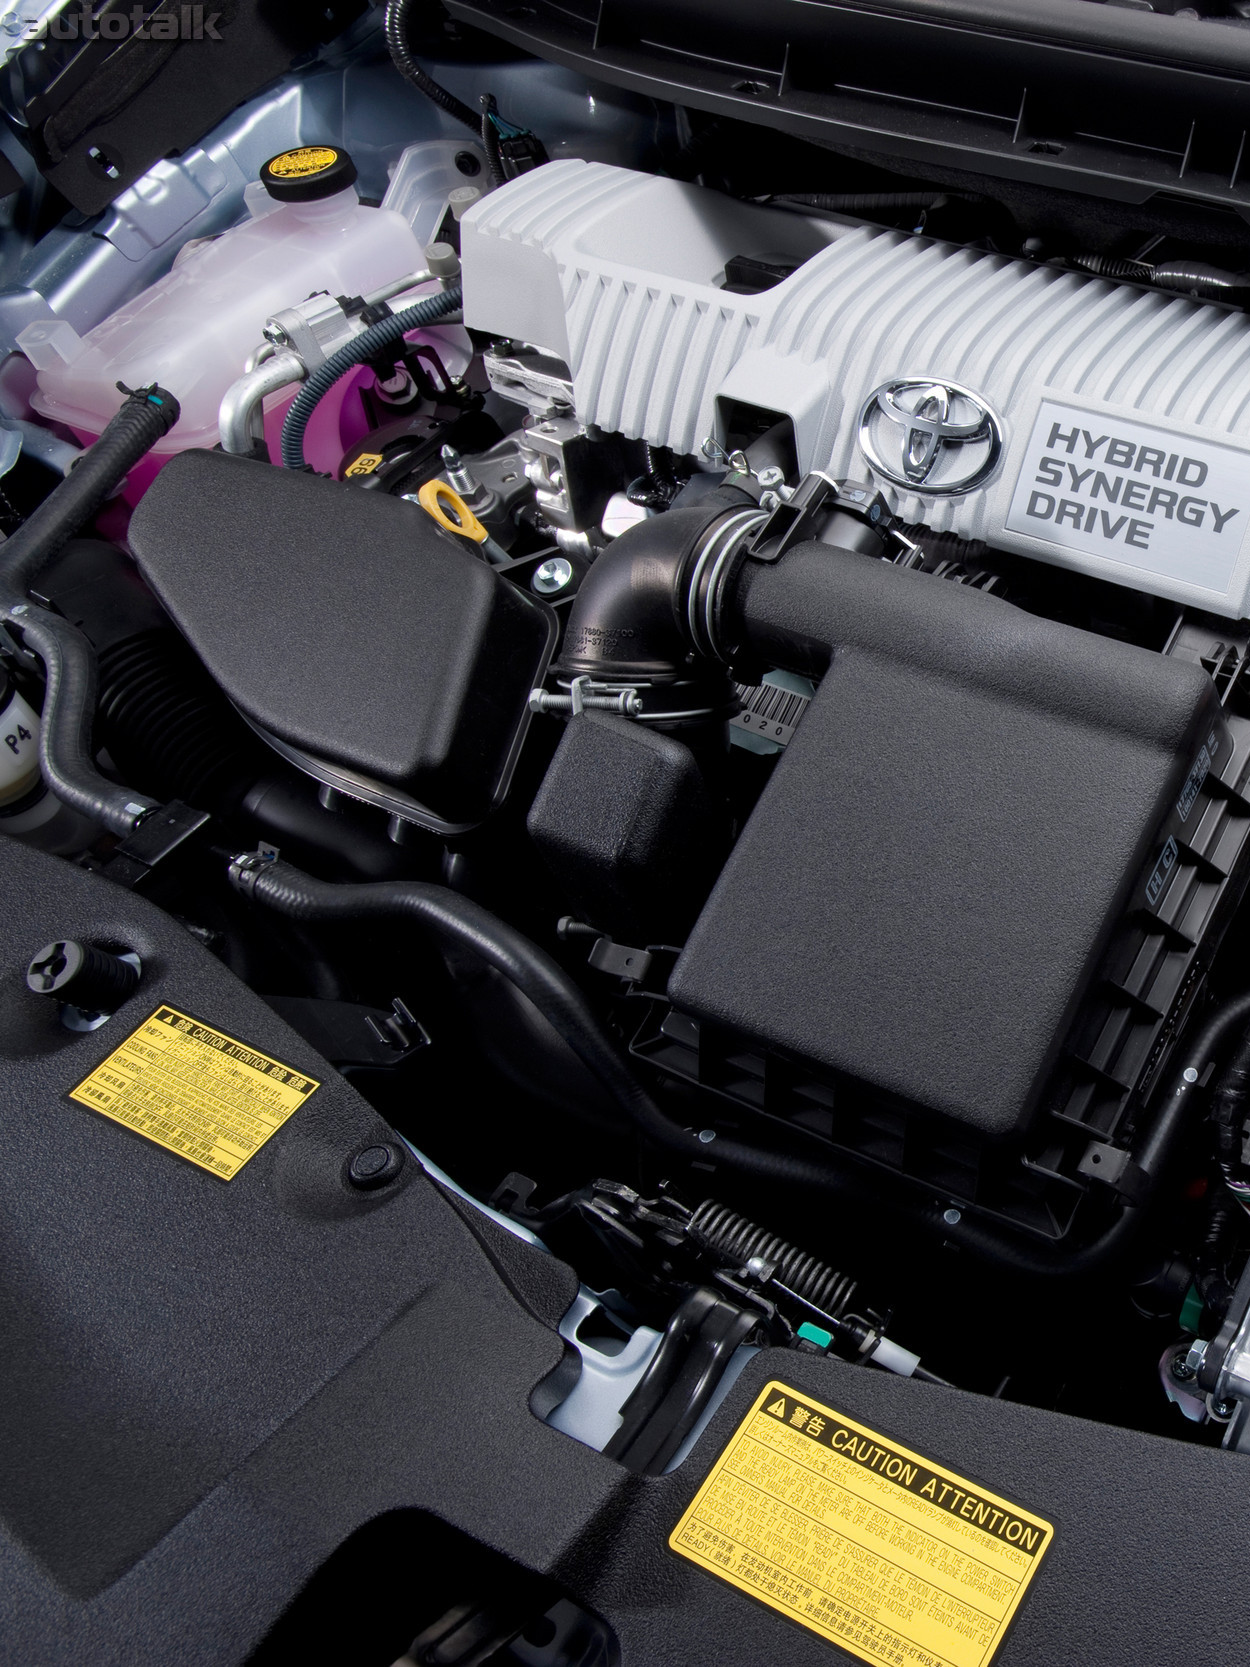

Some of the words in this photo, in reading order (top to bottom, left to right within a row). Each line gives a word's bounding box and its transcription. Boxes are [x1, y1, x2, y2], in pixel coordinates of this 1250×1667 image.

[1046, 422, 1208, 487] HYBRID
[1026, 490, 1154, 550] DRIVE
[1035, 456, 1240, 533] SYNERGY
[4, 724, 32, 755] P4
[190, 1027, 227, 1049] CAUTION
[224, 1044, 270, 1071] ATTENTION
[726, 1457, 741, 1471] SEE
[763, 1478, 790, 1498] MANUAL
[787, 1491, 803, 1506] FOR
[732, 1448, 748, 1462] AND
[746, 1455, 760, 1469] THE
[758, 1462, 780, 1480] READY
[777, 1472, 797, 1489] LAMP
[794, 1482, 807, 1495] ON
[804, 1487, 820, 1502] THE
[817, 1494, 840, 1513] METER
[838, 1505, 853, 1520] ARE
[851, 1513, 866, 1527] OFF
[864, 1520, 889, 1540] BEFORE
[887, 1532, 917, 1555] WORKING
[914, 1547, 925, 1560] IN
[923, 1552, 939, 1567] THE
[936, 1559, 961, 1580] ENGINE
[787, 1405, 828, 1438] 警告
[828, 1426, 918, 1486] CAUTION
[919, 1474, 1039, 1551] ATTENTION
[694, 1506, 715, 1524] POUR
[713, 1517, 733, 1534] PLUS
[730, 1527, 743, 1540] DE
[785, 1558, 797, 1571] LE
[795, 1564, 824, 1586] MANUEL
[822, 1579, 836, 1593] DU
[716, 1472, 734, 1488] AFIN
[759, 1496, 771, 1509] DE
[769, 1501, 781, 1515] SE
[831, 1536, 844, 1550] DE
[877, 1561, 895, 1578] QUE
[892, 1570, 905, 1584] LE
[929, 1590, 942, 1605] DE
[738, 1438, 751, 1451] TO
[749, 1444, 770, 1461] AVOID
[792, 1468, 817, 1487] PLEASE
[816, 1480, 836, 1497] MAKE
[834, 1490, 853, 1507] SURE
[852, 1500, 872, 1517] THAT
[870, 1510, 891, 1528] BOTH
[889, 1520, 905, 1535] THE
[904, 1528, 939, 1554] INDICATOR
[937, 1546, 950, 1560] ON
[949, 1553, 965, 1568] THE
[964, 1561, 990, 1582] POWER
[988, 1574, 1016, 1596] SWITCH
[741, 1517, 765, 1537] TOUTE
[763, 1529, 808, 1561] INTERVENTION
[806, 1554, 827, 1572] DANS
[825, 1564, 837, 1578] LE
[709, 1483, 722, 1496] DE
[719, 1489, 737, 1505] MISE
[734, 1497, 747, 1511] EN
[744, 1503, 768, 1522] ROUTE
[765, 1515, 778, 1528] ET
[775, 1520, 787, 1534] LE
[837, 1555, 851, 1569] DU
[848, 1561, 879, 1585] TABLEAU
[877, 1577, 890, 1591] DE
[887, 1583, 909, 1602] BORD
[907, 1594, 928, 1613] SONT
[953, 1619, 979, 1641] AVANT
[976, 1632, 990, 1648] DE
